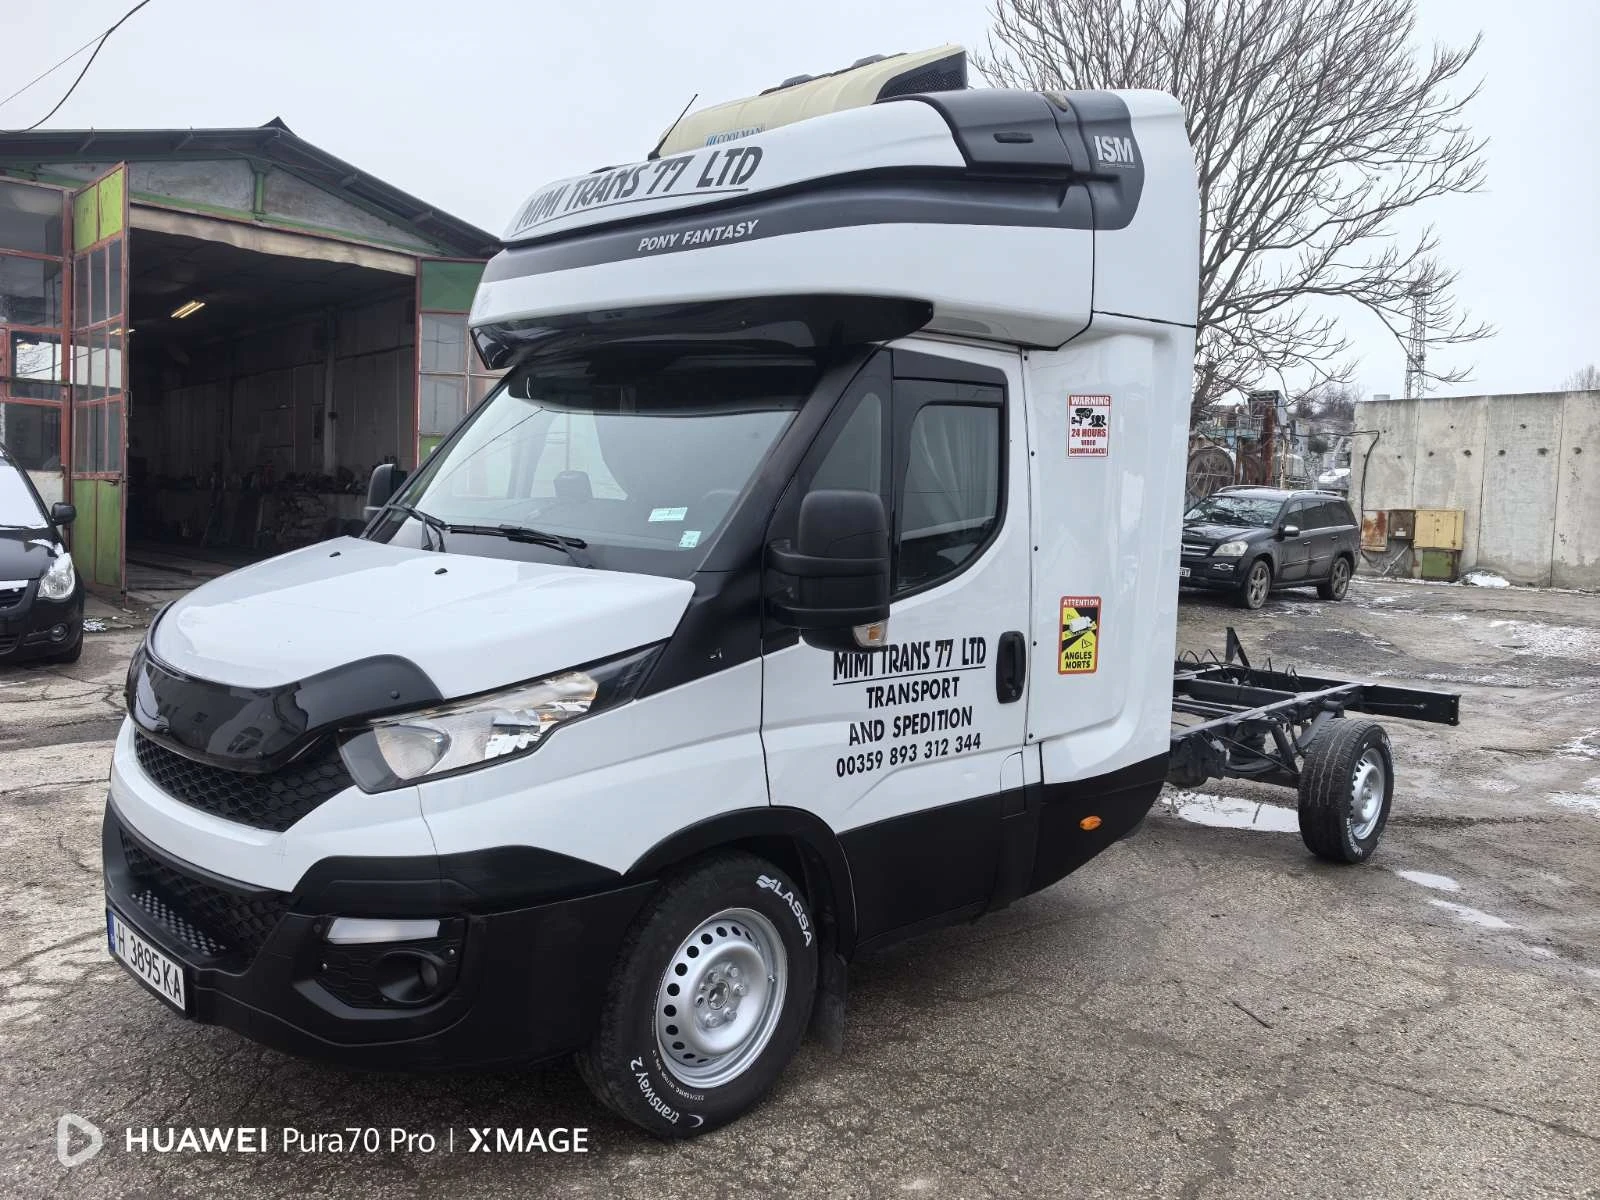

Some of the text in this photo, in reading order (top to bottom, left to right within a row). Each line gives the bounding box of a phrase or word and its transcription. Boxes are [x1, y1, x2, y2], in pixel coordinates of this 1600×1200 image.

[1094, 135, 1134, 162] ISM
[516, 146, 763, 231] MIMI TRANS 77 LTD
[638, 220, 759, 251] PONY FANTASY
[1071, 396, 1110, 406] WARNING
[1071, 428, 1106, 438] 24 HOURS
[1063, 599, 1099, 607] ATTENTION
[833, 637, 987, 680] MIMI TRANS 77 LTD
[1064, 651, 1092, 660] ANGLES
[1065, 660, 1091, 669] MORTS
[866, 677, 960, 709] TRANSPORT
[849, 705, 973, 746] AND SPEDITION
[836, 733, 981, 777] 00359 893 312 344
[773, 880, 813, 947] LASSA
[630, 1056, 644, 1071] 2
[636, 1071, 680, 1125] transway
